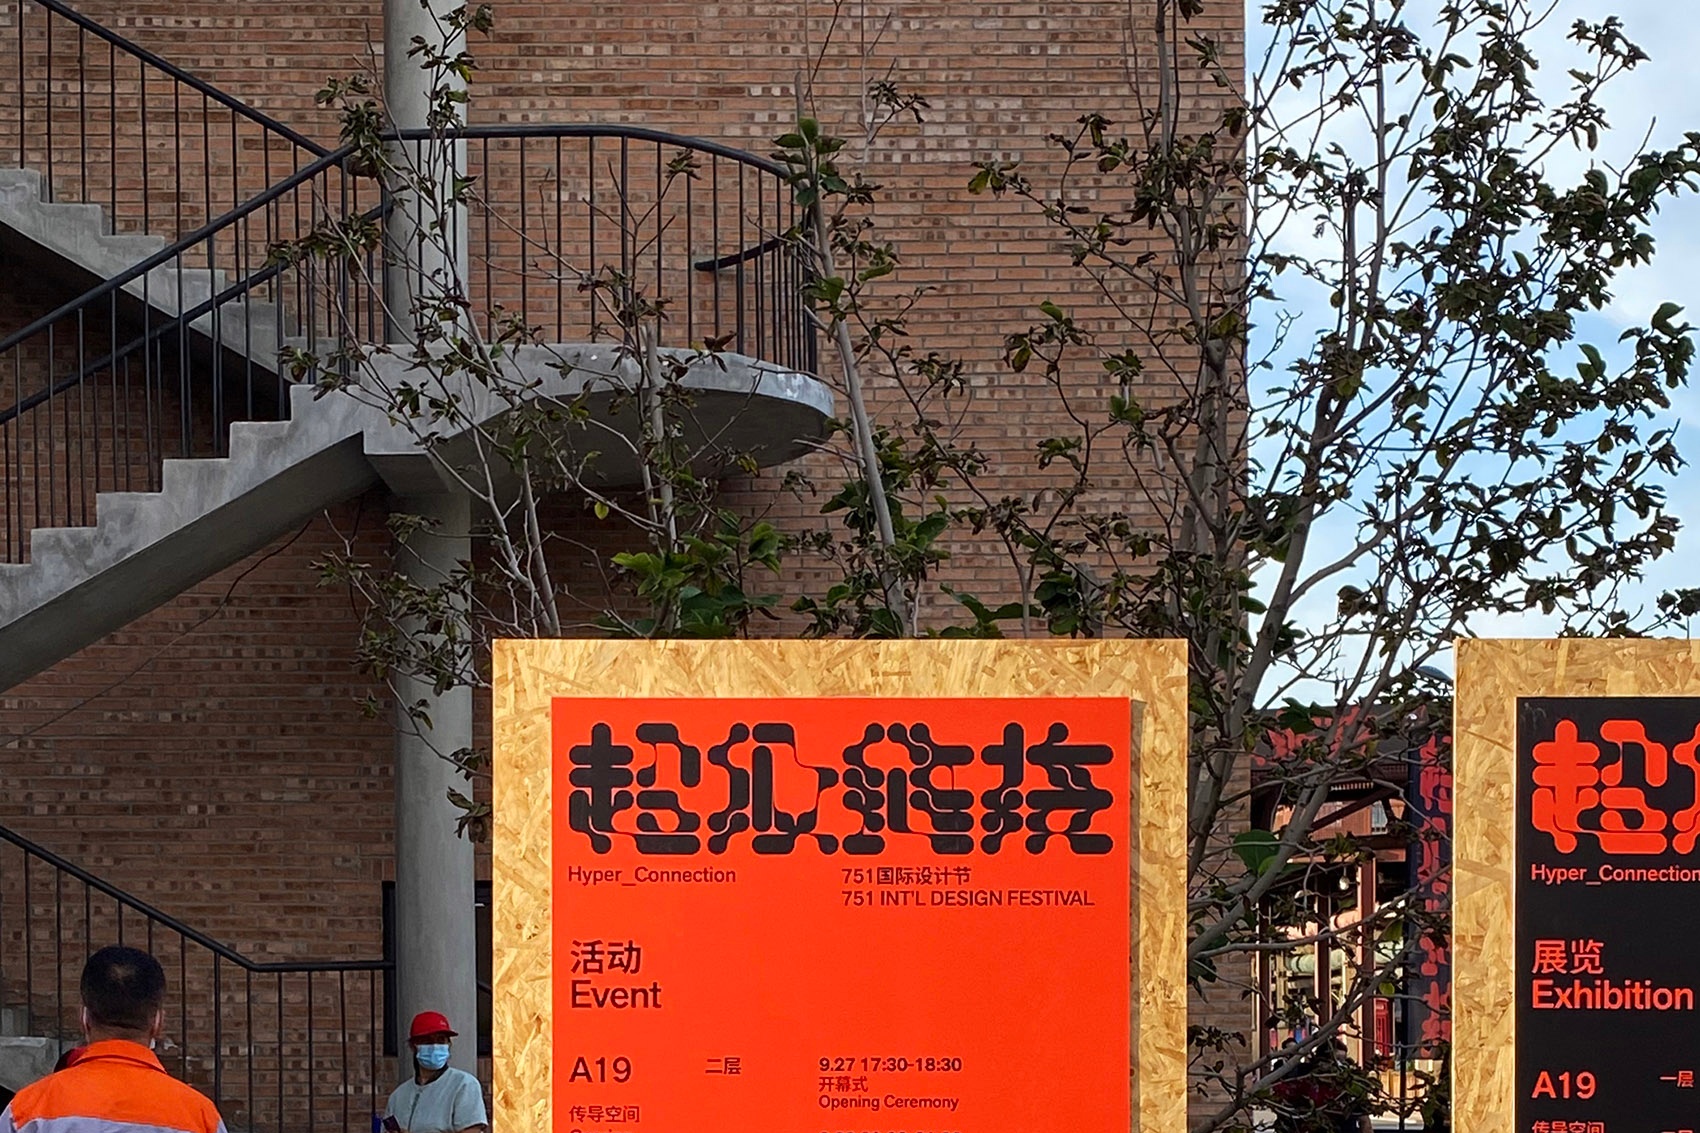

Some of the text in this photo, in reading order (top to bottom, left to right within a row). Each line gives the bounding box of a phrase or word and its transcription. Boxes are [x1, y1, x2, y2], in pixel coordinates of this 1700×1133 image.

[1532, 719, 1700, 855] 超
[568, 865, 736, 887] Hyper_Connection
[841, 866, 971, 886] 751国际设计节
[1531, 864, 1700, 886] Hyper_Connection
[841, 889, 1095, 907] 751 INT'L DESIGN FESTIVAL
[570, 939, 642, 975] 活动
[1531, 938, 1604, 974] 展览
[571, 979, 662, 1009] Event
[1532, 979, 1694, 1011] Exhibition
[569, 1056, 632, 1083] A19
[705, 1057, 742, 1075] 二层
[819, 1057, 962, 1072] 9.27 17:30-18:30
[818, 1076, 869, 1092] 开幕式
[1531, 1070, 1596, 1099] A19
[1659, 1070, 1695, 1088] 一层
[569, 1105, 641, 1123] 传导空间
[818, 1094, 960, 1112] Opening Ceremony
